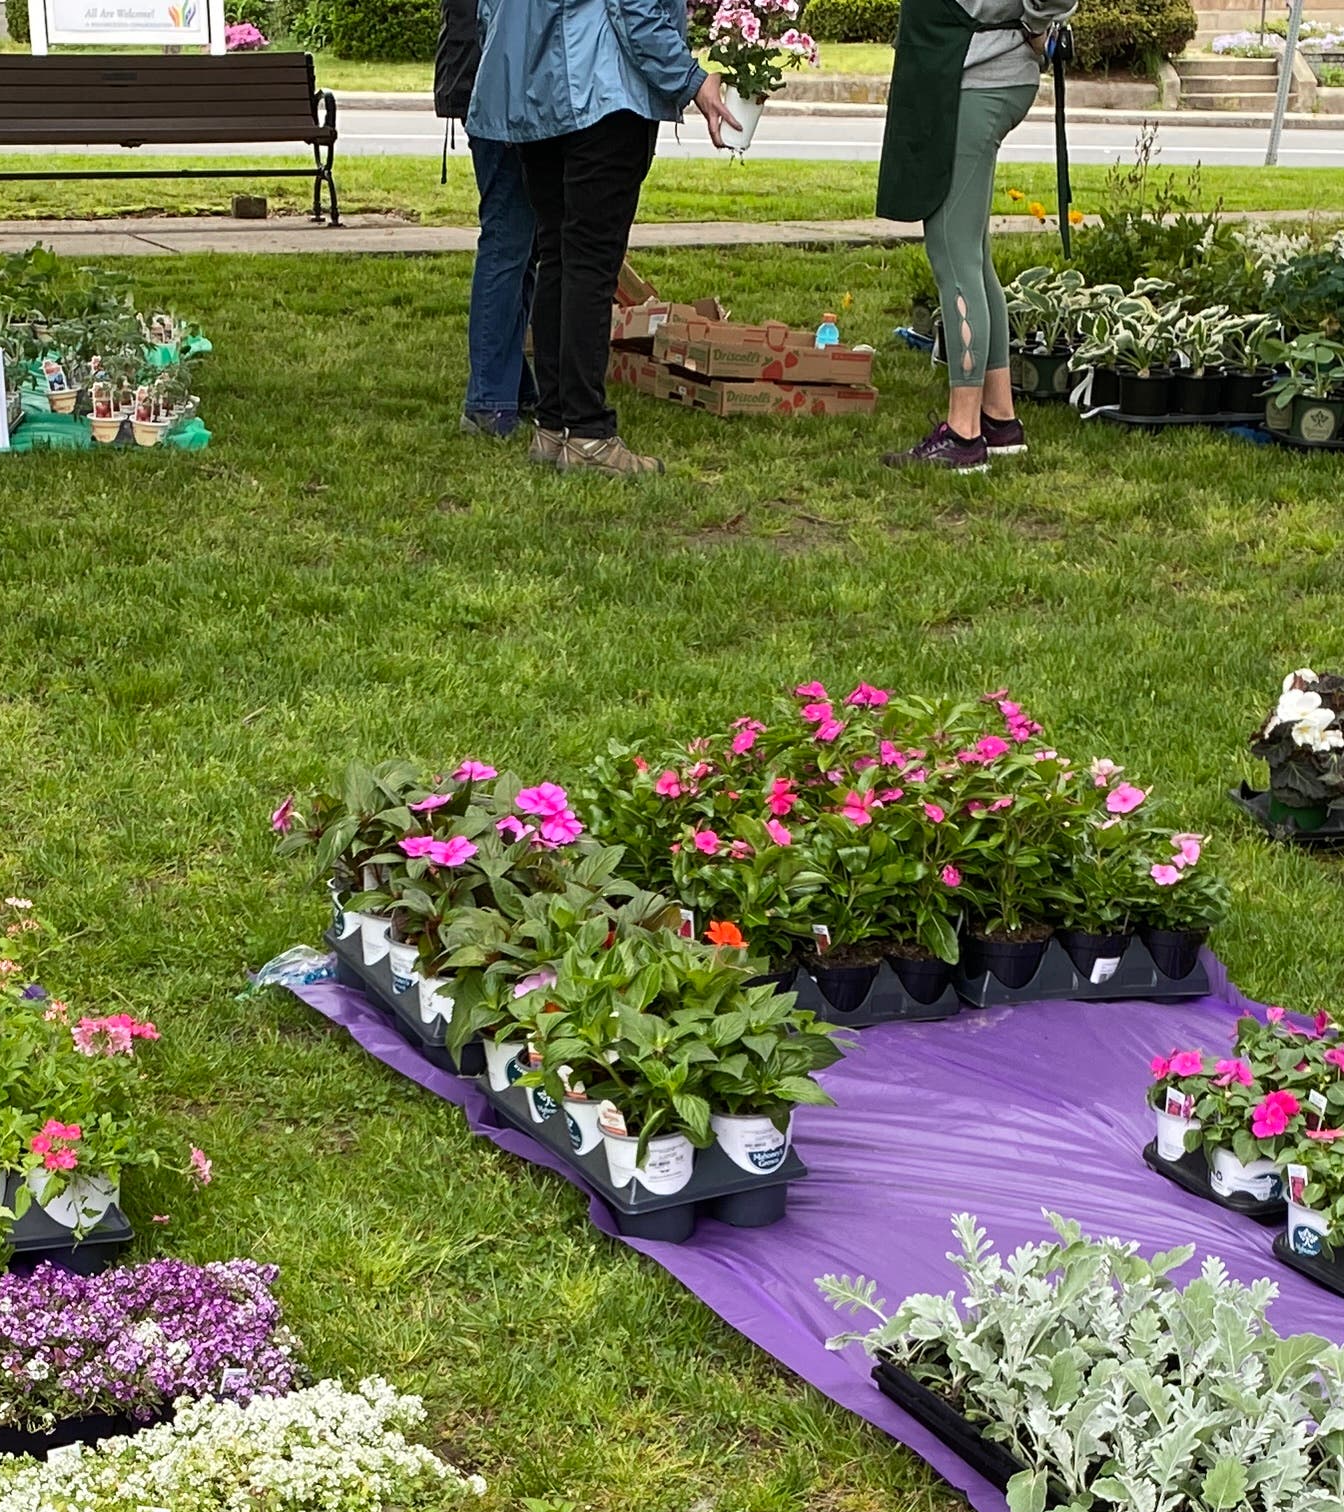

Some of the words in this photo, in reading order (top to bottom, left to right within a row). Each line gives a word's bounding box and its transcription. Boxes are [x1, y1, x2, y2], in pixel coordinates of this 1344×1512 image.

[84, 8, 98, 18] All
[99, 8, 115, 18] Are
[116, 7, 156, 18] Welcome!
